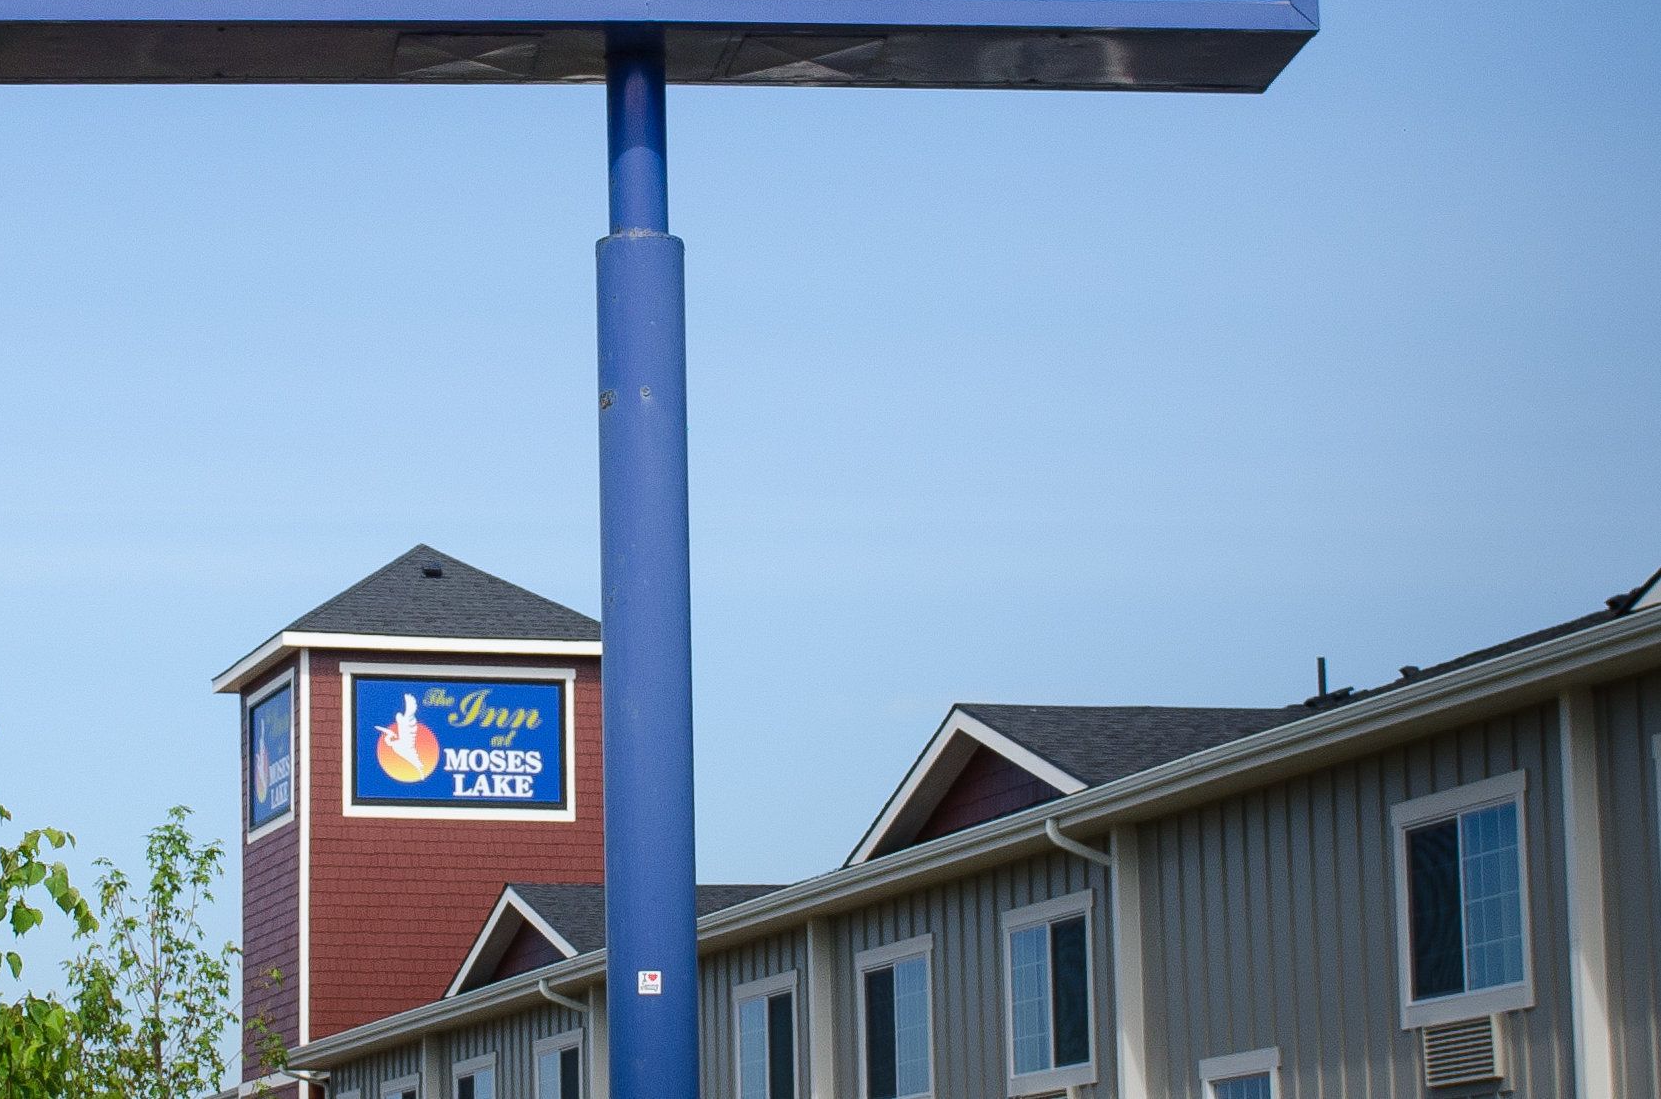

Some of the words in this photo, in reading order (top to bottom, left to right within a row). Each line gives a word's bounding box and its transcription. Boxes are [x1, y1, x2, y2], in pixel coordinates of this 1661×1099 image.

[447, 688, 541, 729] Inn
[490, 730, 516, 747] at
[443, 748, 543, 774] MOSES
[453, 774, 534, 798] LAKE
